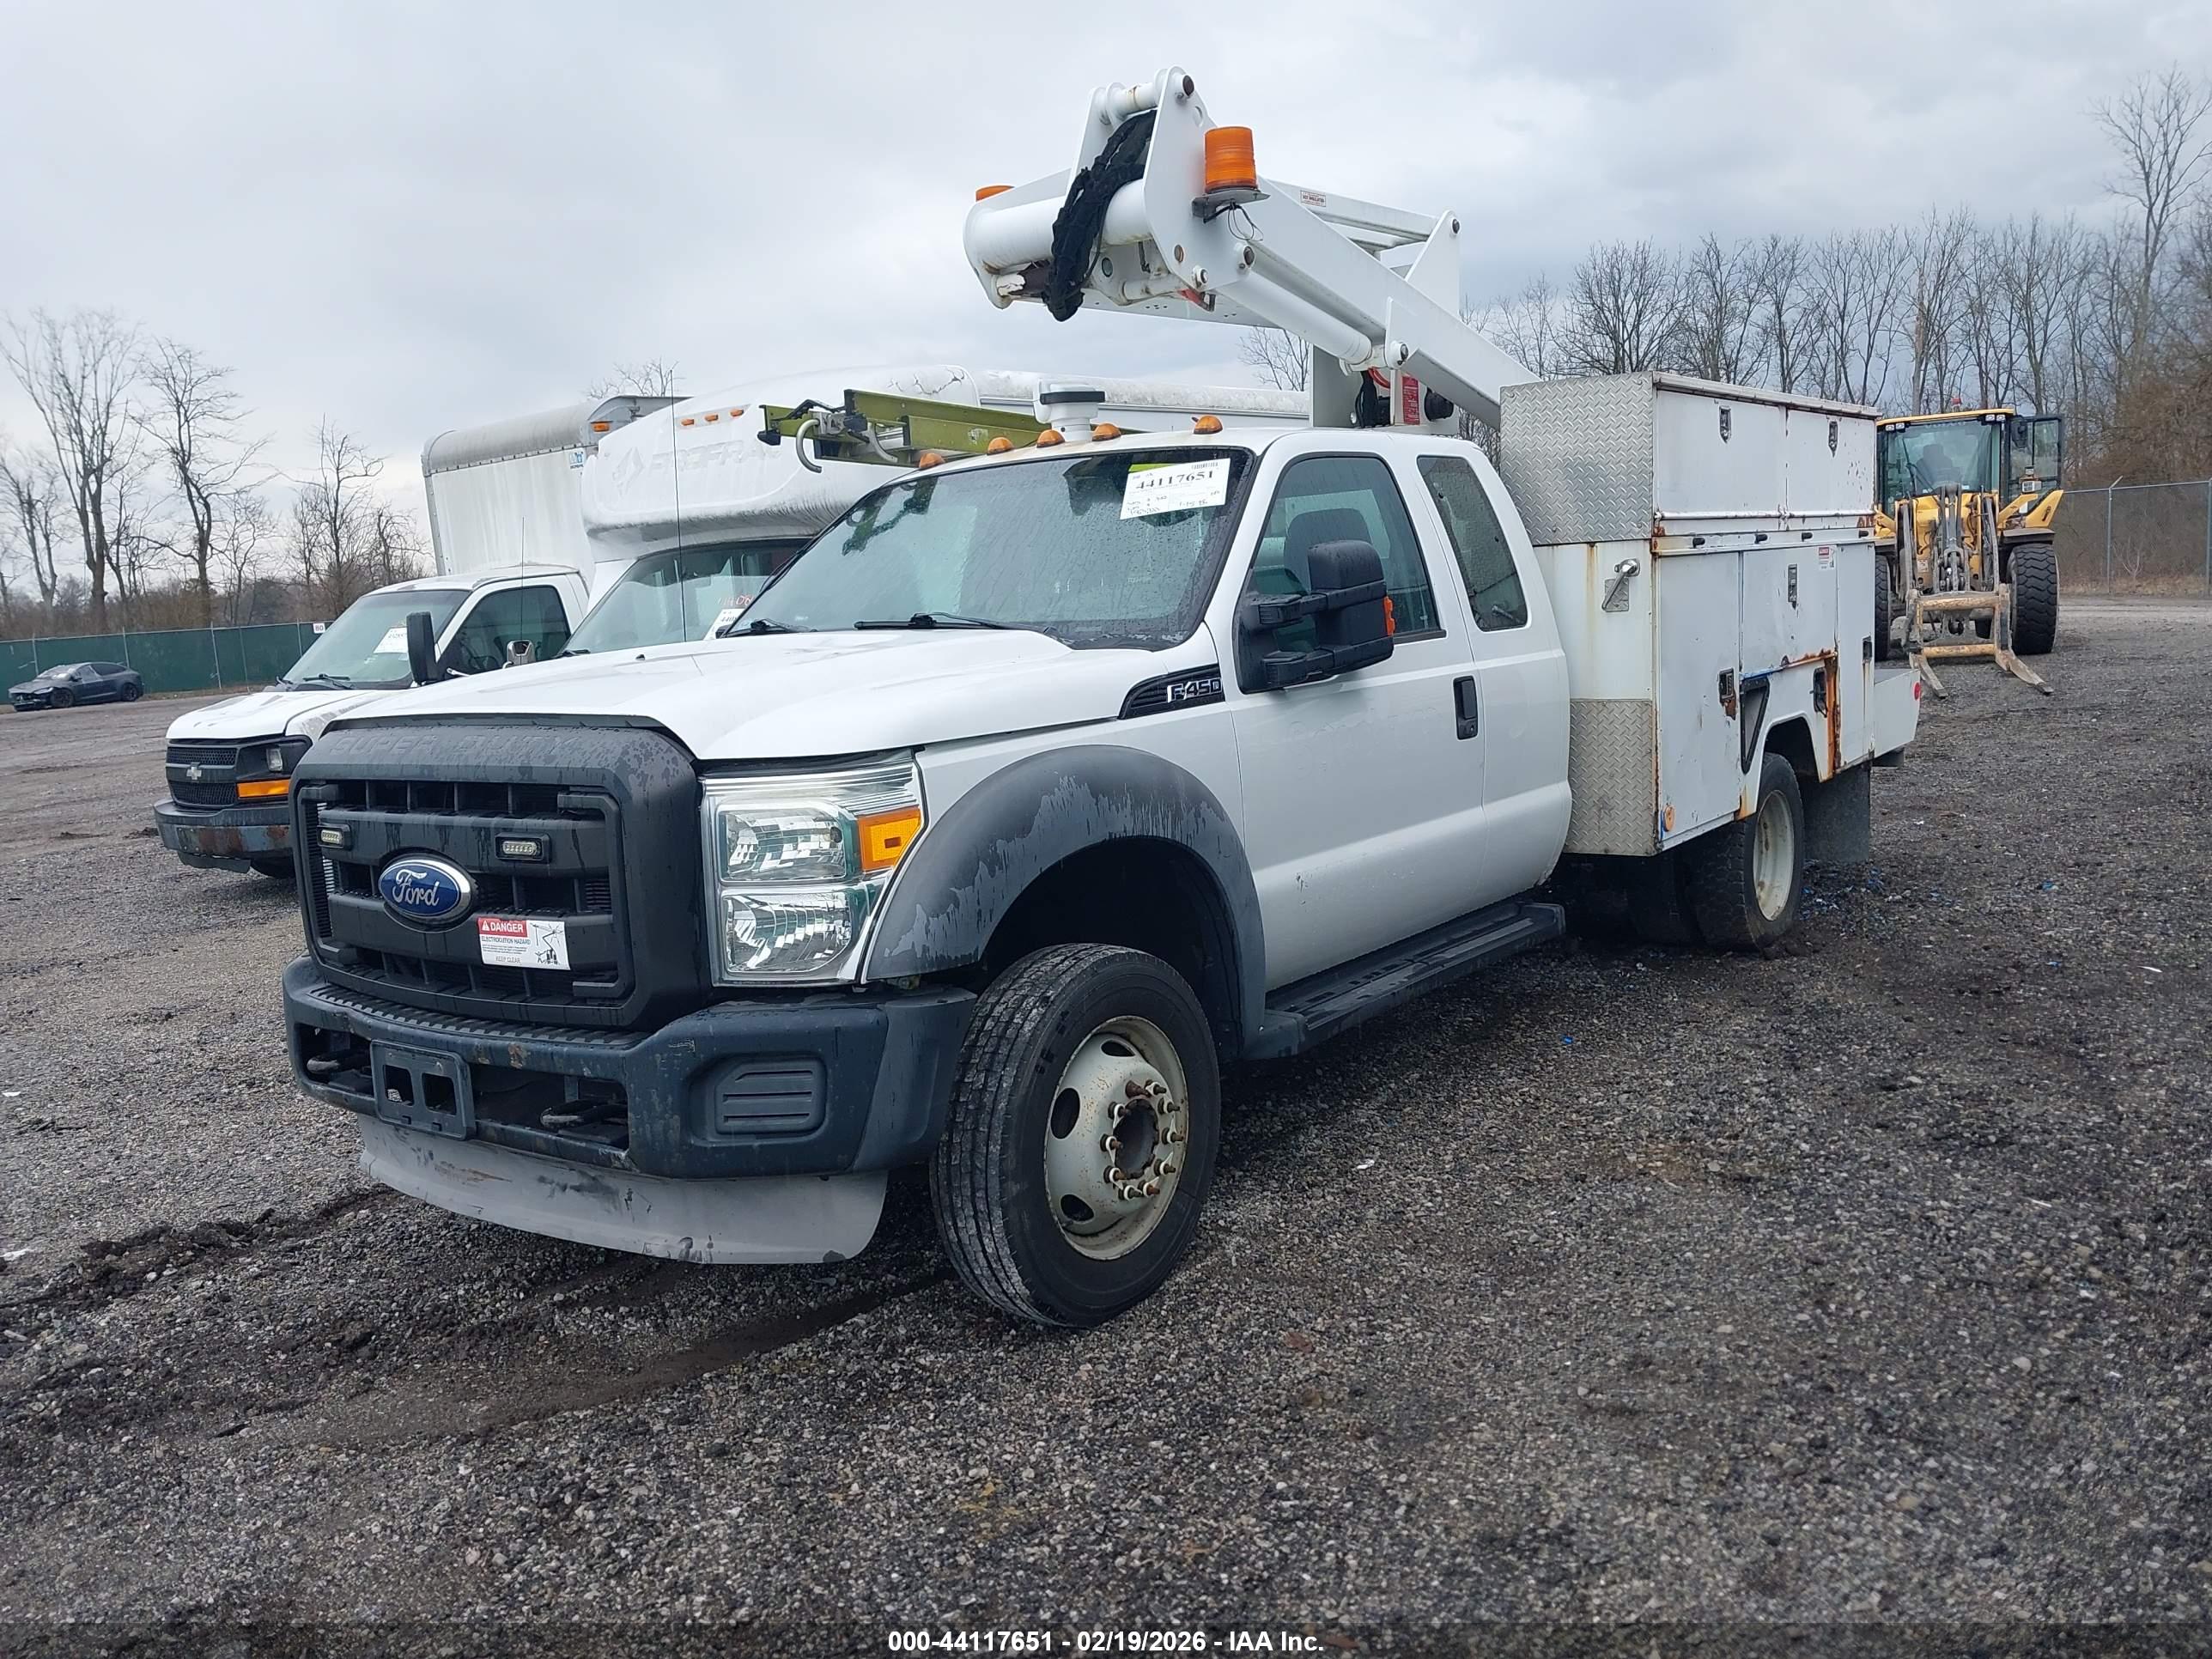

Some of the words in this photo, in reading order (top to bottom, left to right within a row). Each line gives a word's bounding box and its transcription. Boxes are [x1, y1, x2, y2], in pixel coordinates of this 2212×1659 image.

[1135, 471, 1213, 489] 44117651
[392, 869, 440, 907] Ford
[490, 921, 524, 933] DANGER
